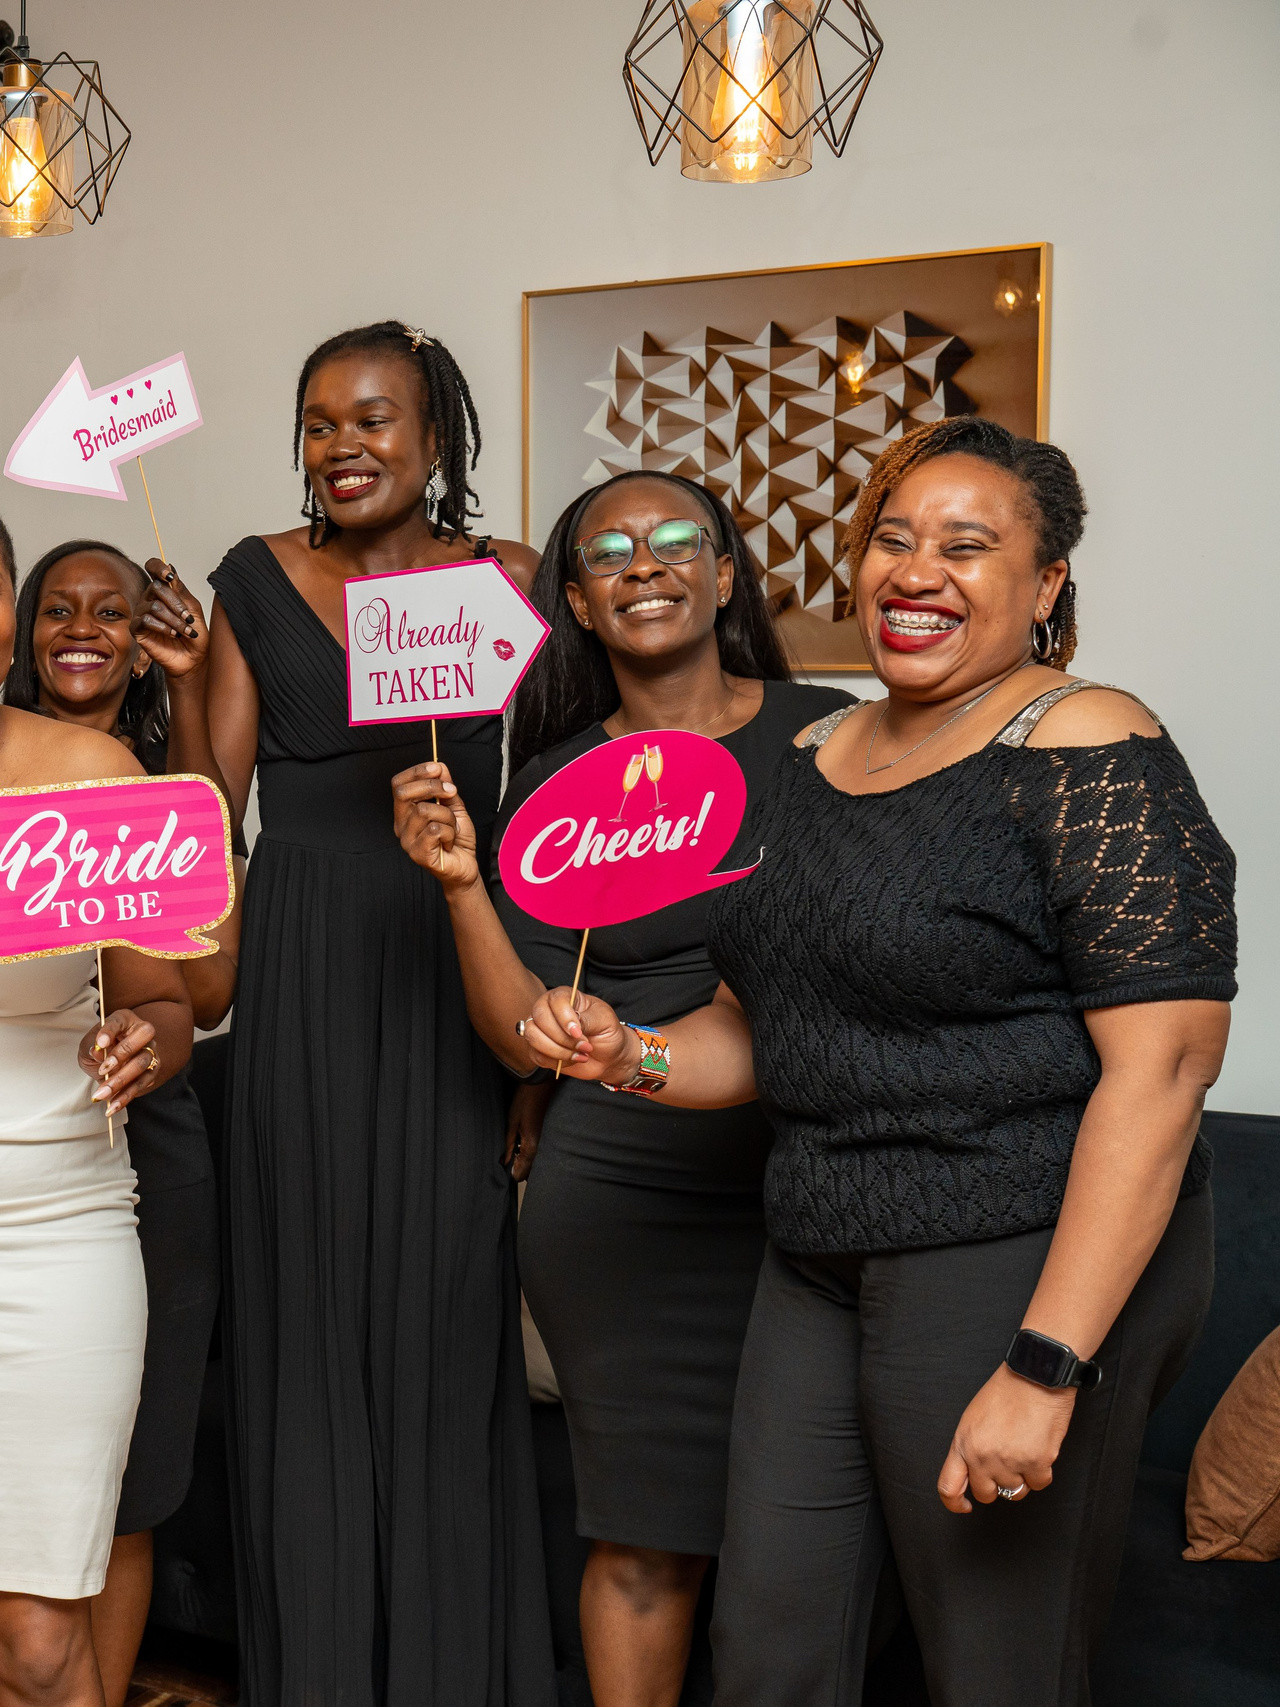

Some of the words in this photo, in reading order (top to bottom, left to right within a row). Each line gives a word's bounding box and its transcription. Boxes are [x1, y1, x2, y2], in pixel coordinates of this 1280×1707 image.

[73, 390, 178, 461] Bridesmaid
[354, 597, 485, 657] Already
[369, 662, 475, 706] TAKEN
[520, 791, 715, 884] Cheers!
[50, 897, 105, 929] TO
[116, 891, 163, 922] BE
